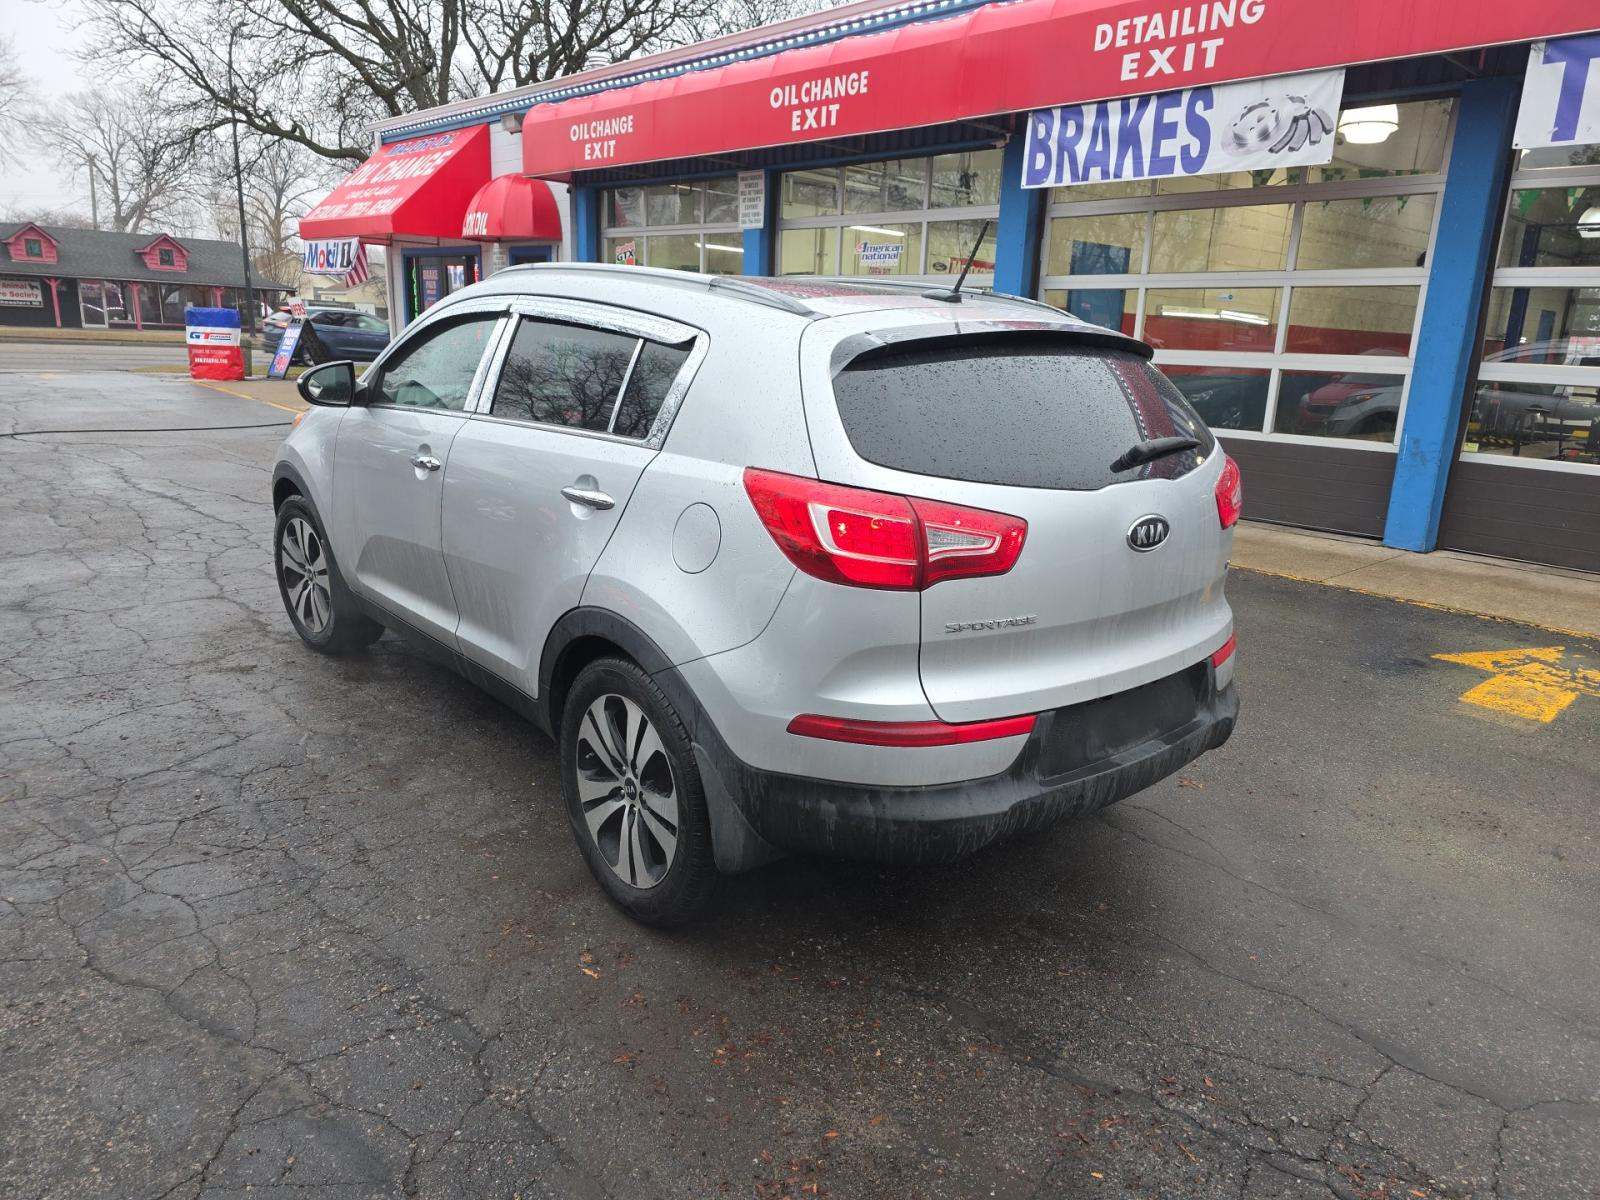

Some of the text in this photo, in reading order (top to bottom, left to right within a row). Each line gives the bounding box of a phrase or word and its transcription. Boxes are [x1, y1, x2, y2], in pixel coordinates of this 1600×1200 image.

[1093, 0, 1267, 52] DETAILING
[1119, 38, 1224, 81] EXIT
[791, 103, 840, 132] EXIT
[1025, 86, 1214, 187] BRAKES
[585, 139, 616, 161] EXIT
[370, 149, 454, 184] CHANGE
[617, 250, 634, 261] GTX
[861, 241, 904, 254] American
[861, 250, 900, 260] national
[9, 290, 38, 299] Society
[1136, 522, 1165, 545] KIA
[945, 614, 1041, 634] SPORTAGE
